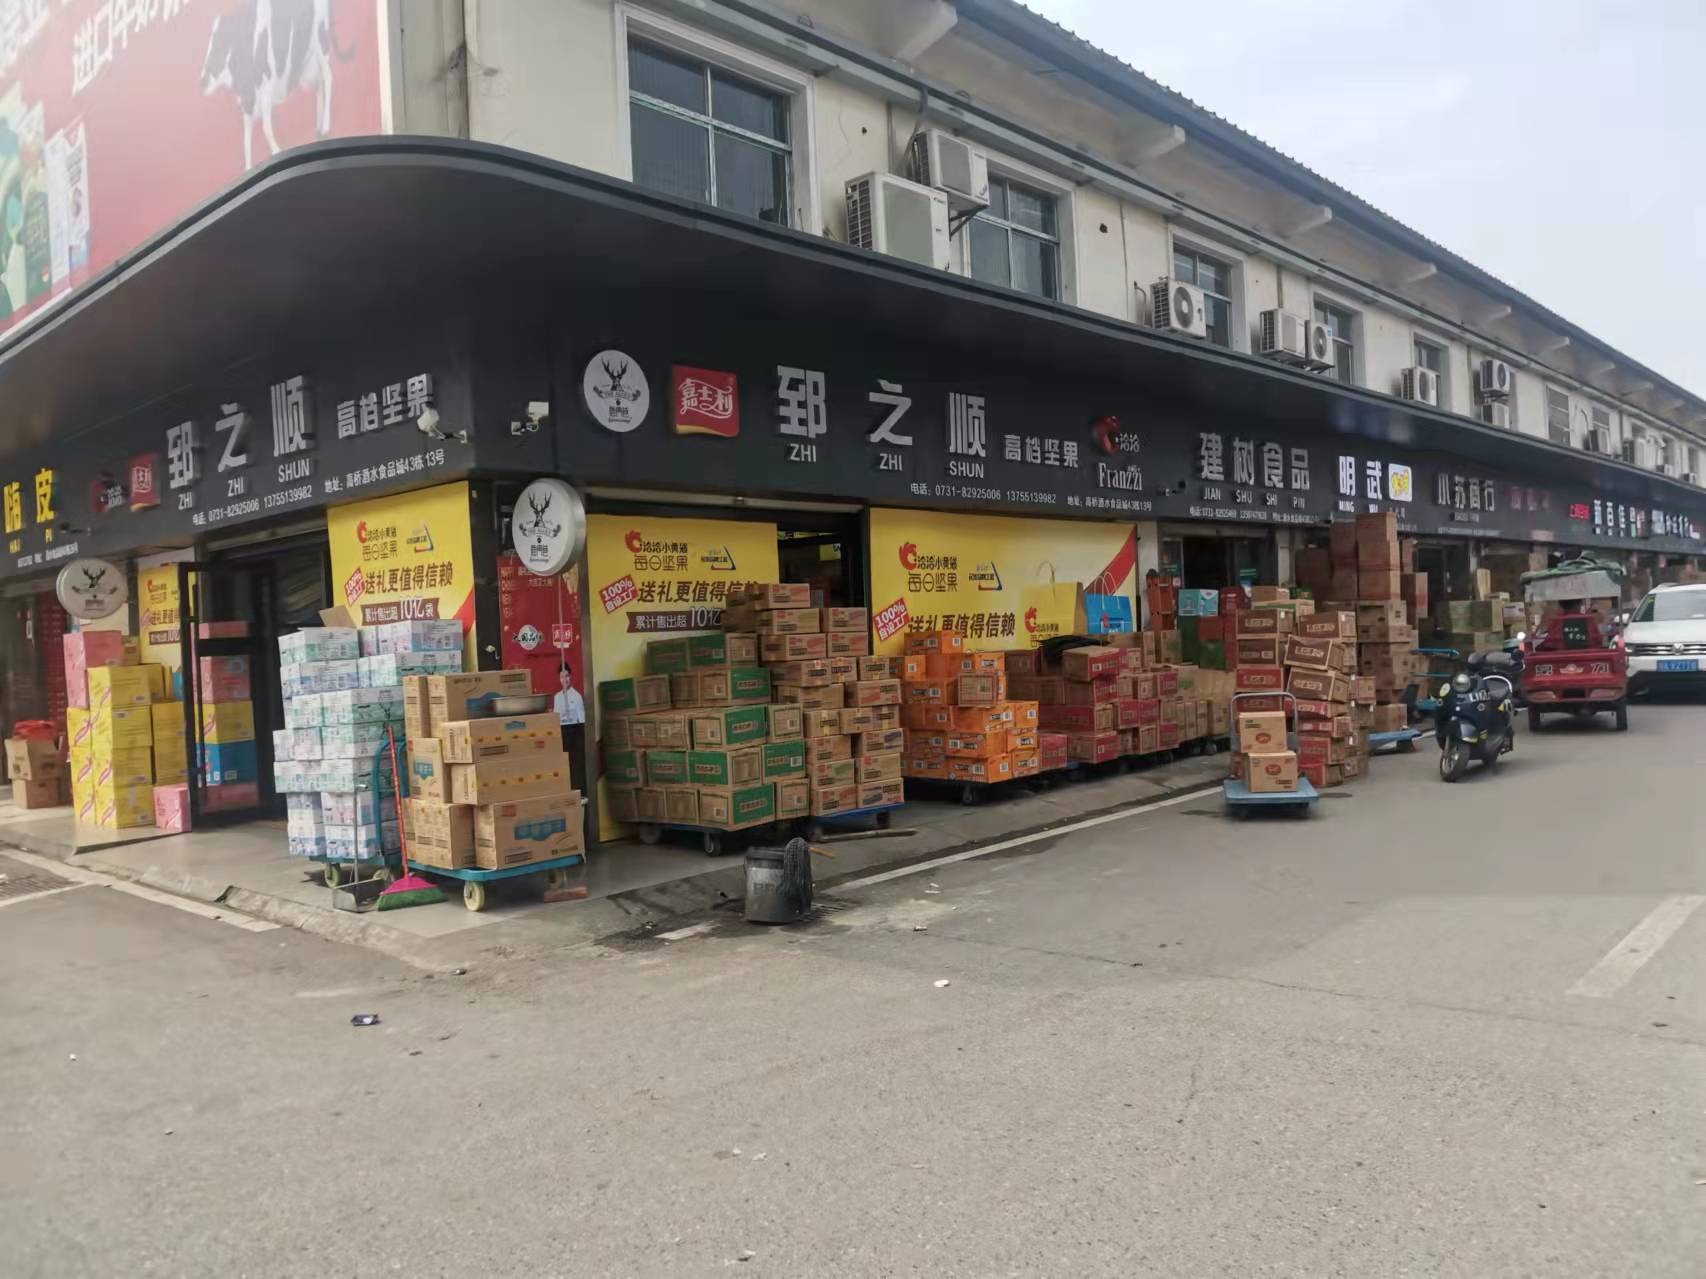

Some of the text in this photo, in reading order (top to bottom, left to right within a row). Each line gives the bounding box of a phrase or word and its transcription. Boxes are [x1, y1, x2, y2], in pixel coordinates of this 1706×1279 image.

[337, 373, 430, 440] 高档坚果
[682, 378, 733, 413] 嘉士利
[790, 442, 985, 479] ZHI ZHI SHUN
[1003, 434, 1079, 468] 高档坚果
[1200, 432, 1310, 490] 建树食品
[178, 459, 310, 510] ZHI ZHI SHUN
[1098, 462, 1143, 491] Franzzi
[1338, 455, 1382, 500] 明武
[1203, 487, 1305, 509] JIAN SHU SHI PIN
[1338, 500, 1355, 512] MING
[365, 560, 453, 595] 送礼更值得信赖
[634, 554, 689, 571] 每日坚果
[602, 577, 633, 601] 100%
[908, 571, 959, 592] 每日坚果
[875, 601, 906, 628] 100%
[908, 612, 1016, 639] 送礼更值得信赖
